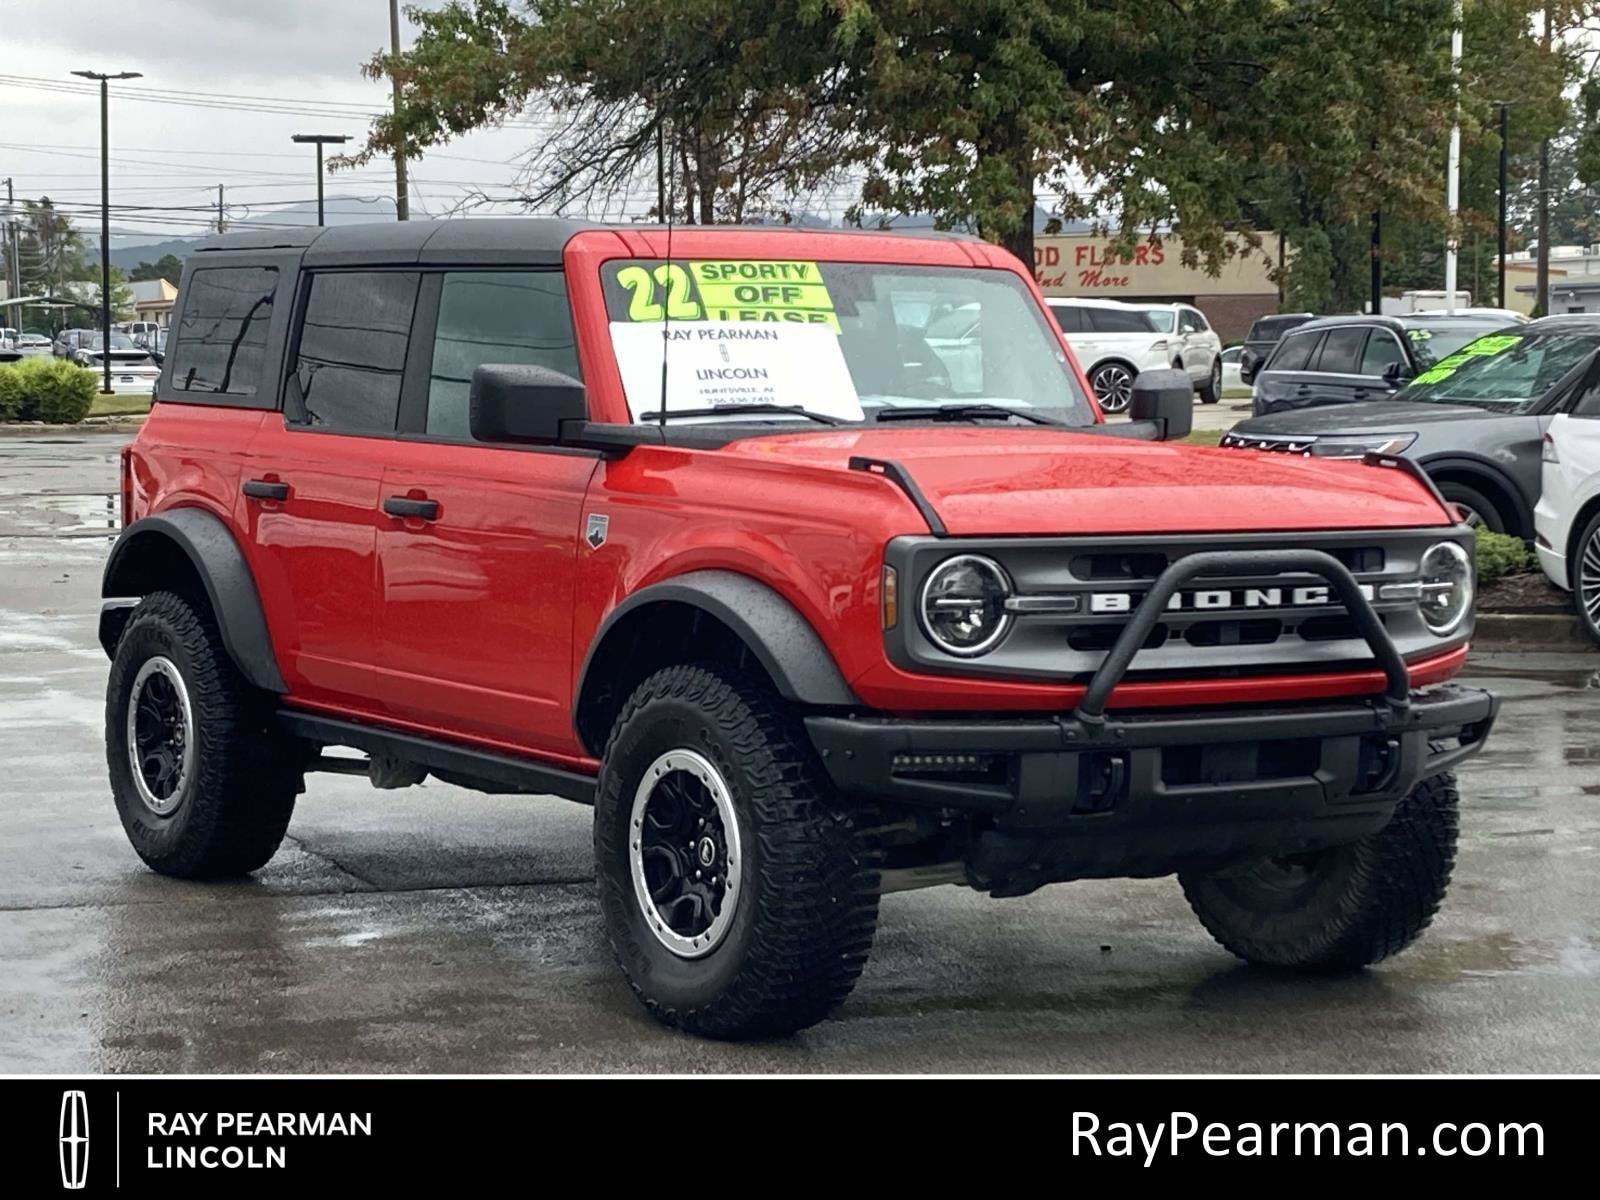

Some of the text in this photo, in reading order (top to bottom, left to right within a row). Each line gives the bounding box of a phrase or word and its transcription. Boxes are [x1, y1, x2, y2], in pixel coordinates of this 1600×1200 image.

[700, 263, 808, 280] SPORTY
[1078, 270, 1129, 287] More
[617, 265, 700, 322] 22
[735, 285, 803, 304] OFF
[662, 329, 778, 341] RAY PEARMAN
[1407, 329, 1433, 341] 25
[696, 368, 768, 381] LINCOLN
